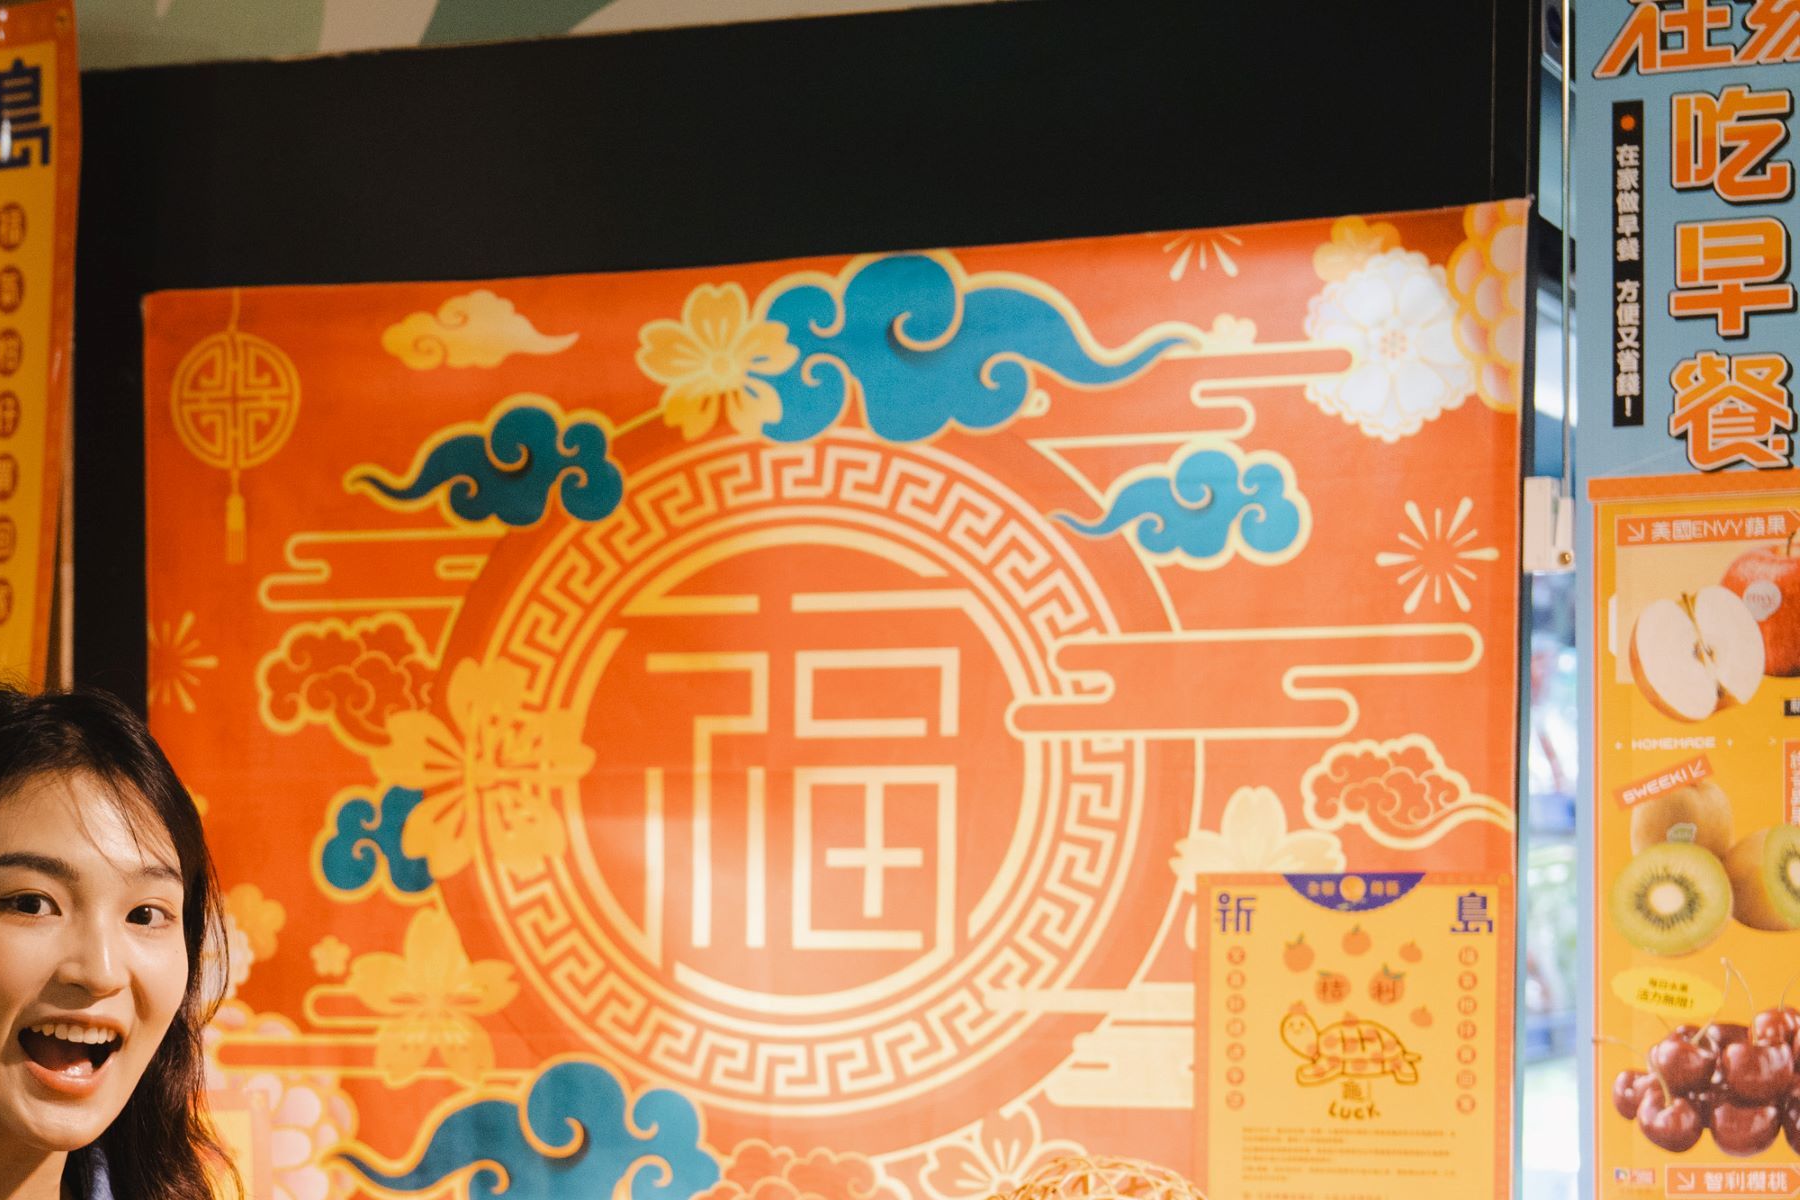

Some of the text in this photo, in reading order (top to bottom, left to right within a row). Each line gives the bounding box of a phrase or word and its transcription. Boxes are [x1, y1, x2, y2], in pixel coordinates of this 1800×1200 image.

[1616, 143, 1641, 262] 在家做早餐
[1670, 84, 1798, 472] 吃早餐
[622, 588, 968, 962] 福
[1450, 892, 1493, 933] 島
